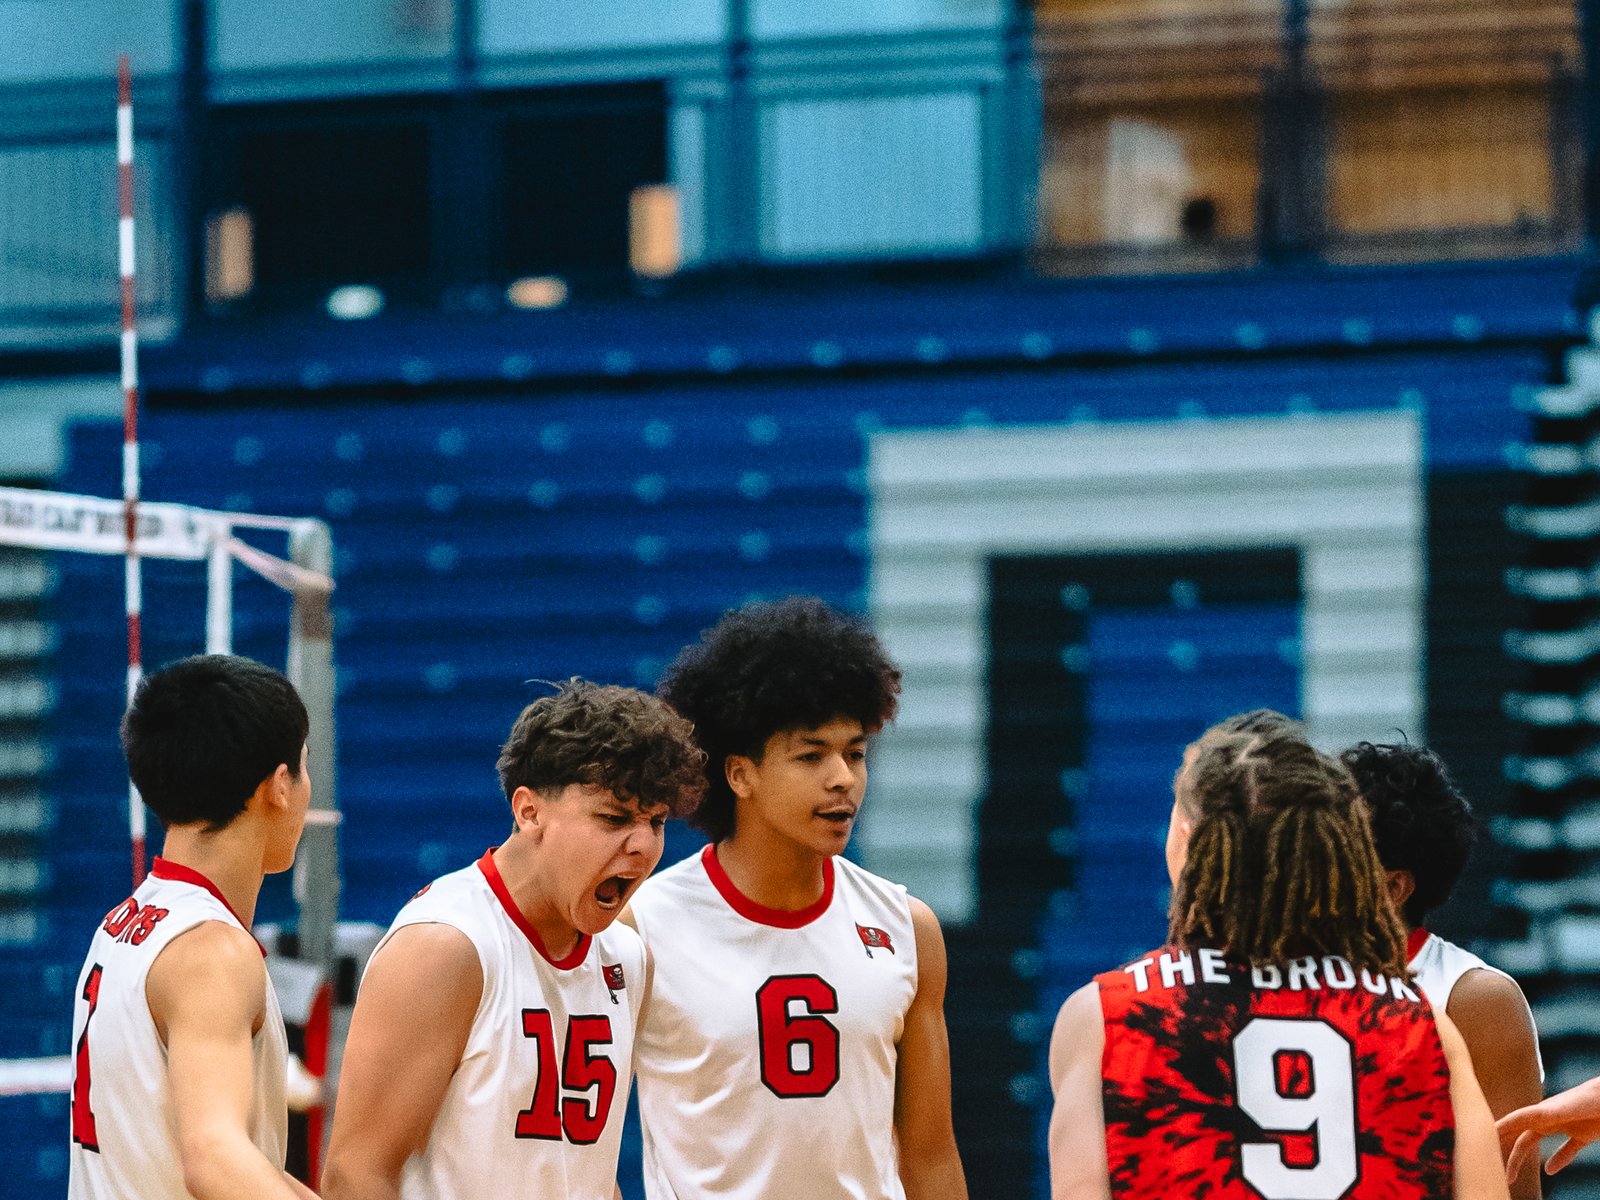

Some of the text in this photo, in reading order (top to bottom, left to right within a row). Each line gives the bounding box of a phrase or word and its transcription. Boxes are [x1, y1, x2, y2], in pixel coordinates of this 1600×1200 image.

[1124, 947, 1231, 993] THE
[71, 961, 102, 1154] 1
[514, 1008, 617, 1145] 15
[756, 973, 841, 1099] 6
